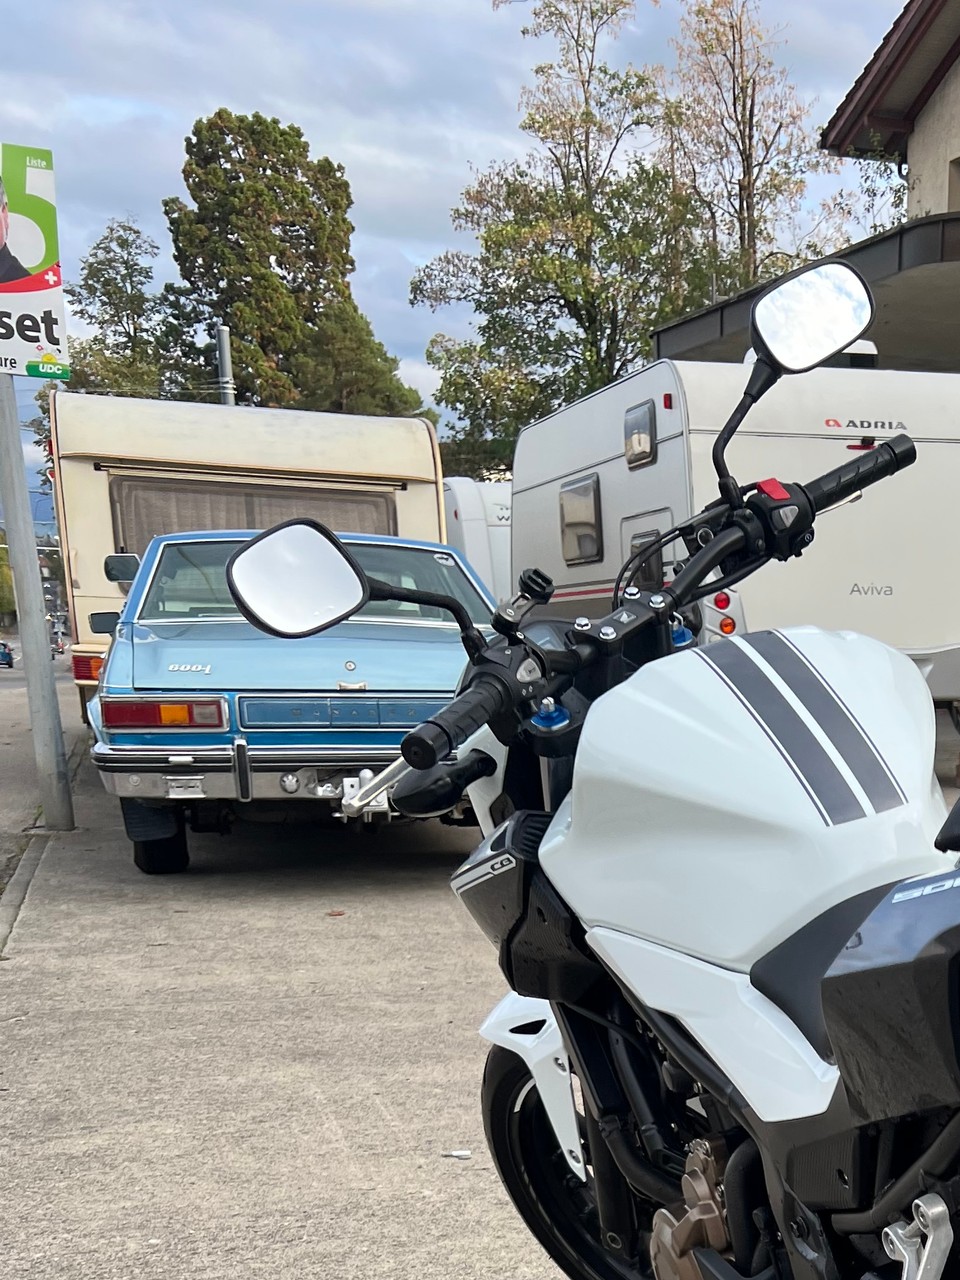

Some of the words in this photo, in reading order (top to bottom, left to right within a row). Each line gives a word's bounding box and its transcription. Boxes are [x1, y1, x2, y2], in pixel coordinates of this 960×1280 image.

[26, 156, 47, 168] Liste
[38, 363, 63, 374] UDC
[846, 419, 908, 430] ADRIA
[849, 582, 894, 597] Aviva
[490, 857, 514, 872] CB
